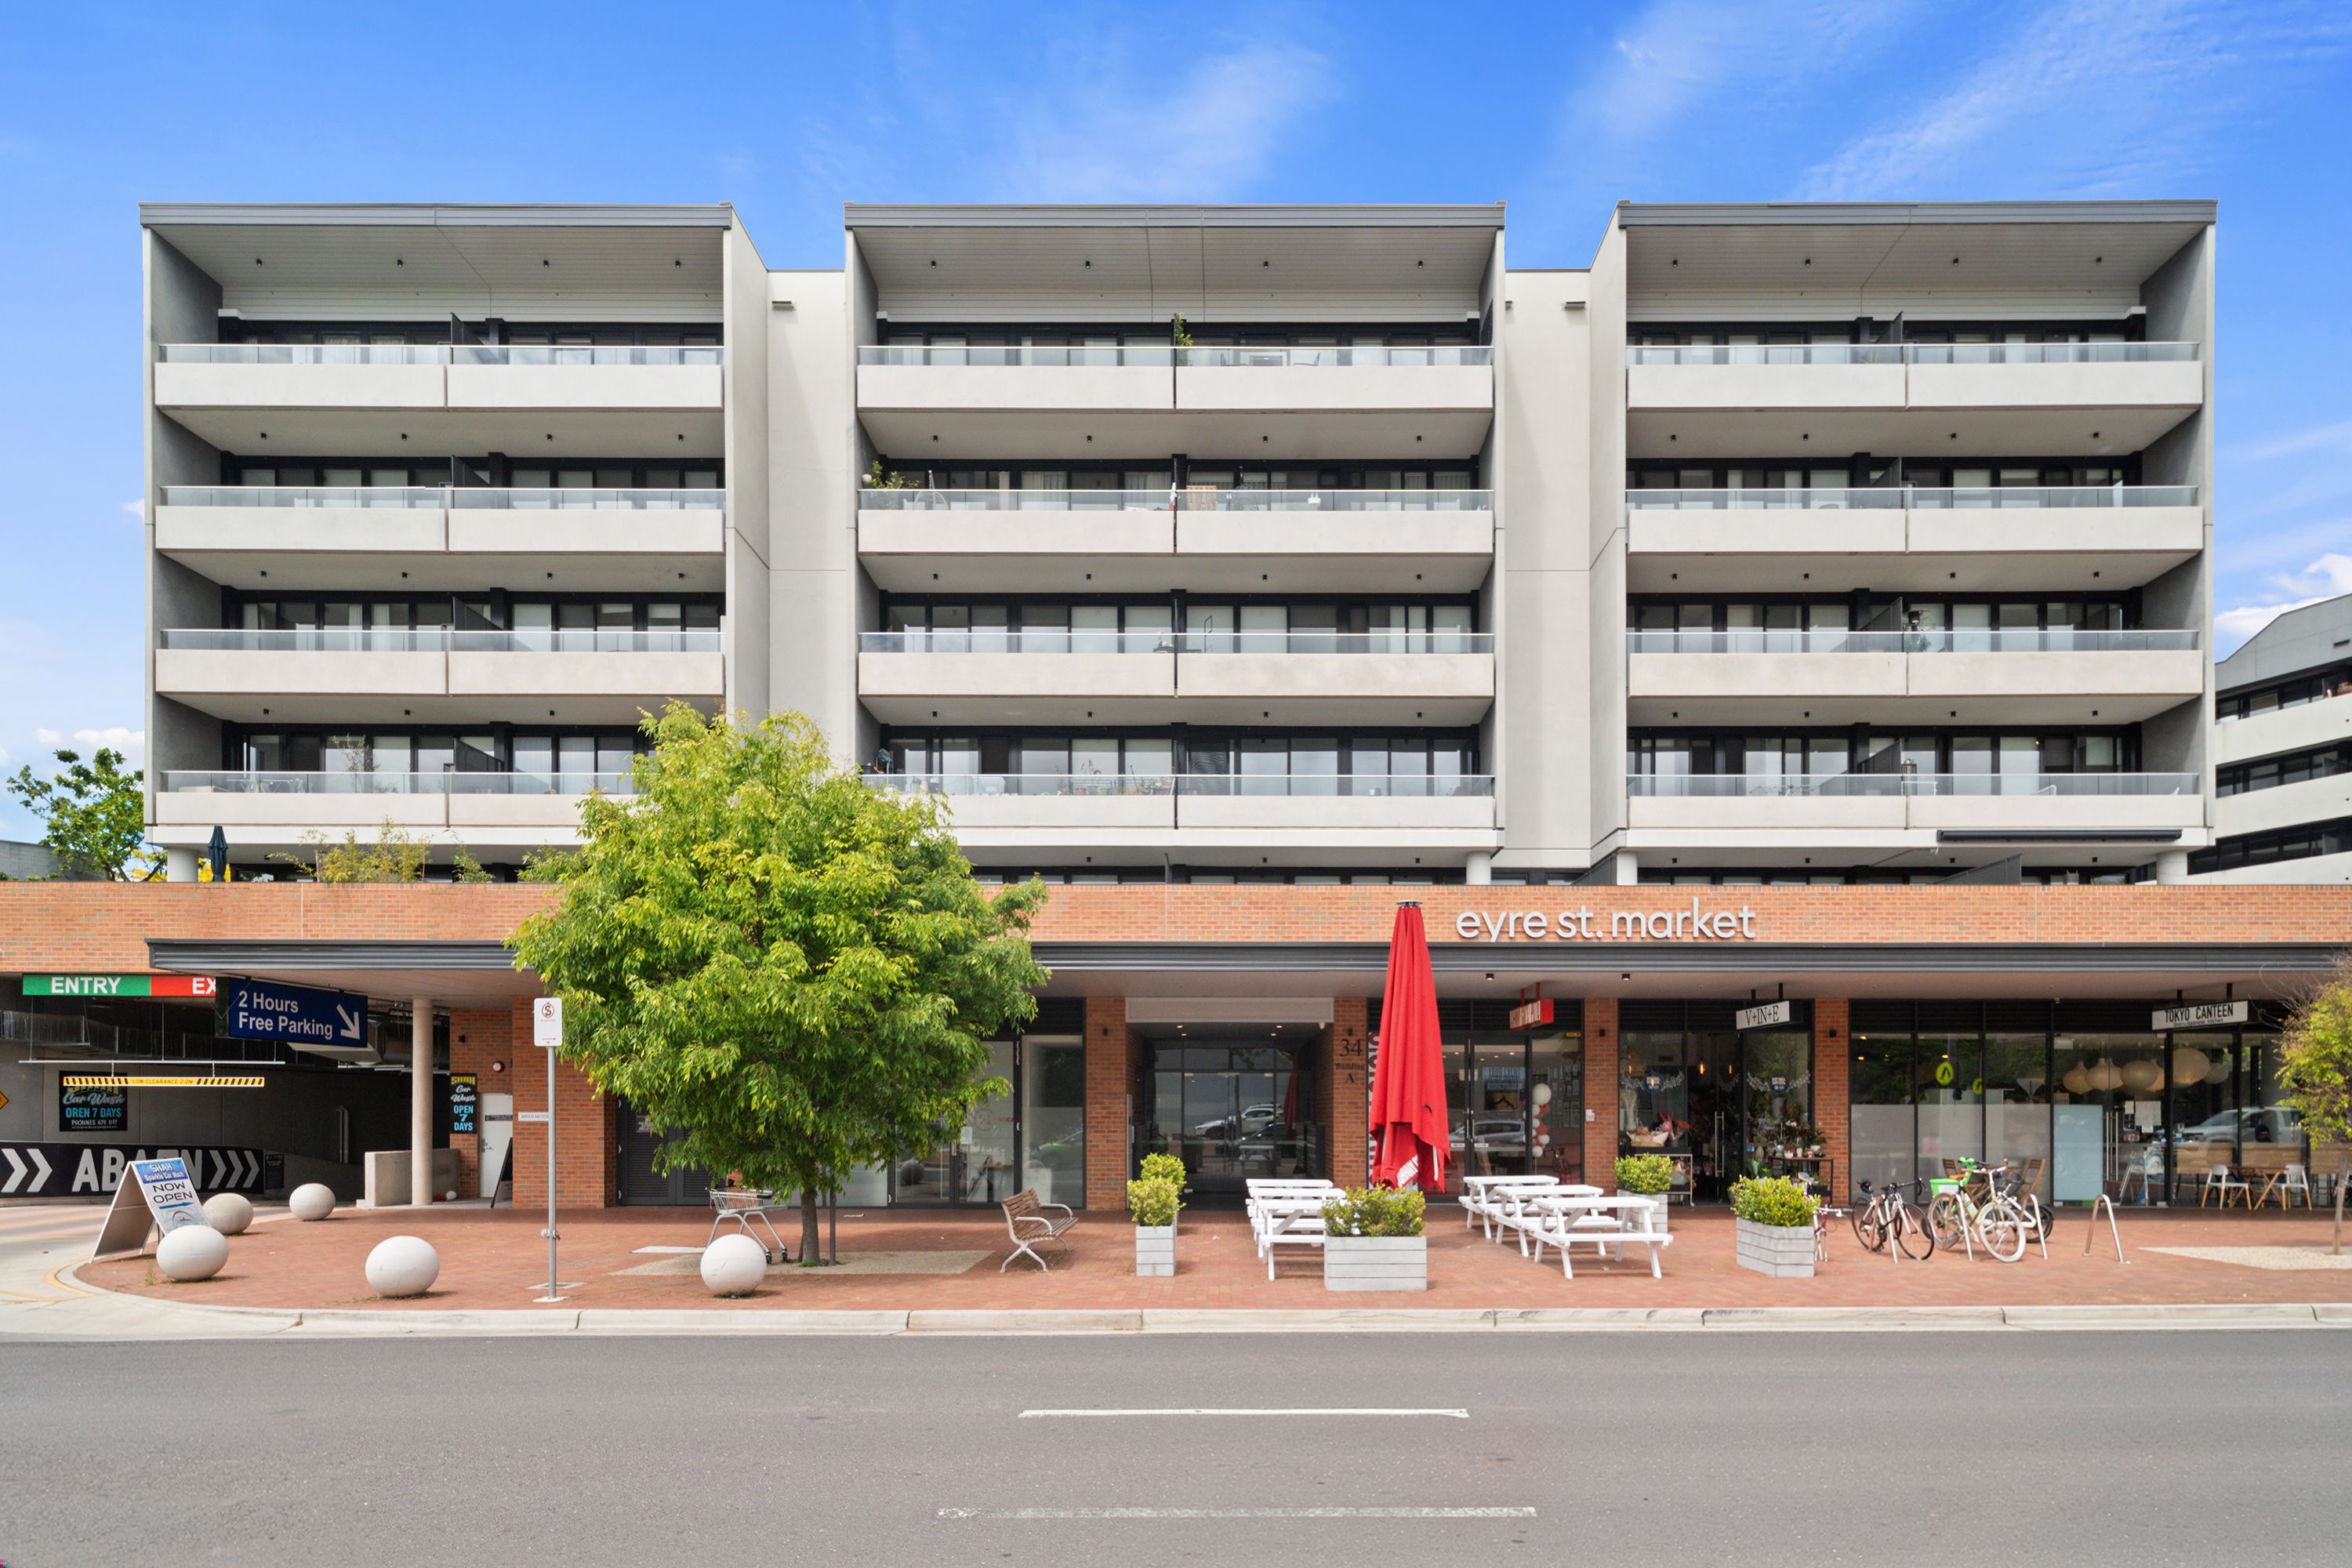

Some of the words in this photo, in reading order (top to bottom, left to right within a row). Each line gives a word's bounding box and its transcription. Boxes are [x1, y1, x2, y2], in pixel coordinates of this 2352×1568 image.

[1455, 910, 1548, 942] eyre
[1555, 905, 1604, 938] st.
[1612, 896, 1756, 938] market
[51, 977, 122, 994] ENTRY
[238, 991, 248, 1007] 2
[253, 992, 299, 1013] Hours
[1745, 1004, 1780, 1026] V+IN+E
[2164, 1007, 2190, 1022] TOKYO
[2195, 1004, 2234, 1020] CANTEEN
[238, 1011, 274, 1031] Free
[278, 1015, 333, 1040] Parking
[1339, 1038, 1363, 1057] 34
[1335, 1062, 1365, 1072] Building
[1345, 1072, 1355, 1083] A
[456, 1084, 471, 1093] Car
[63, 1092, 86, 1105] Car
[87, 1092, 125, 1105] Wash
[451, 1094, 477, 1102] Wash
[92, 1107, 98, 1118] 7
[100, 1107, 122, 1118] DAYS
[453, 1105, 474, 1114] OPEN
[454, 1122, 473, 1131] DAYS
[150, 1163, 173, 1173] SHAH
[153, 1181, 186, 1193] NOW
[153, 1191, 194, 1203] OPEN
